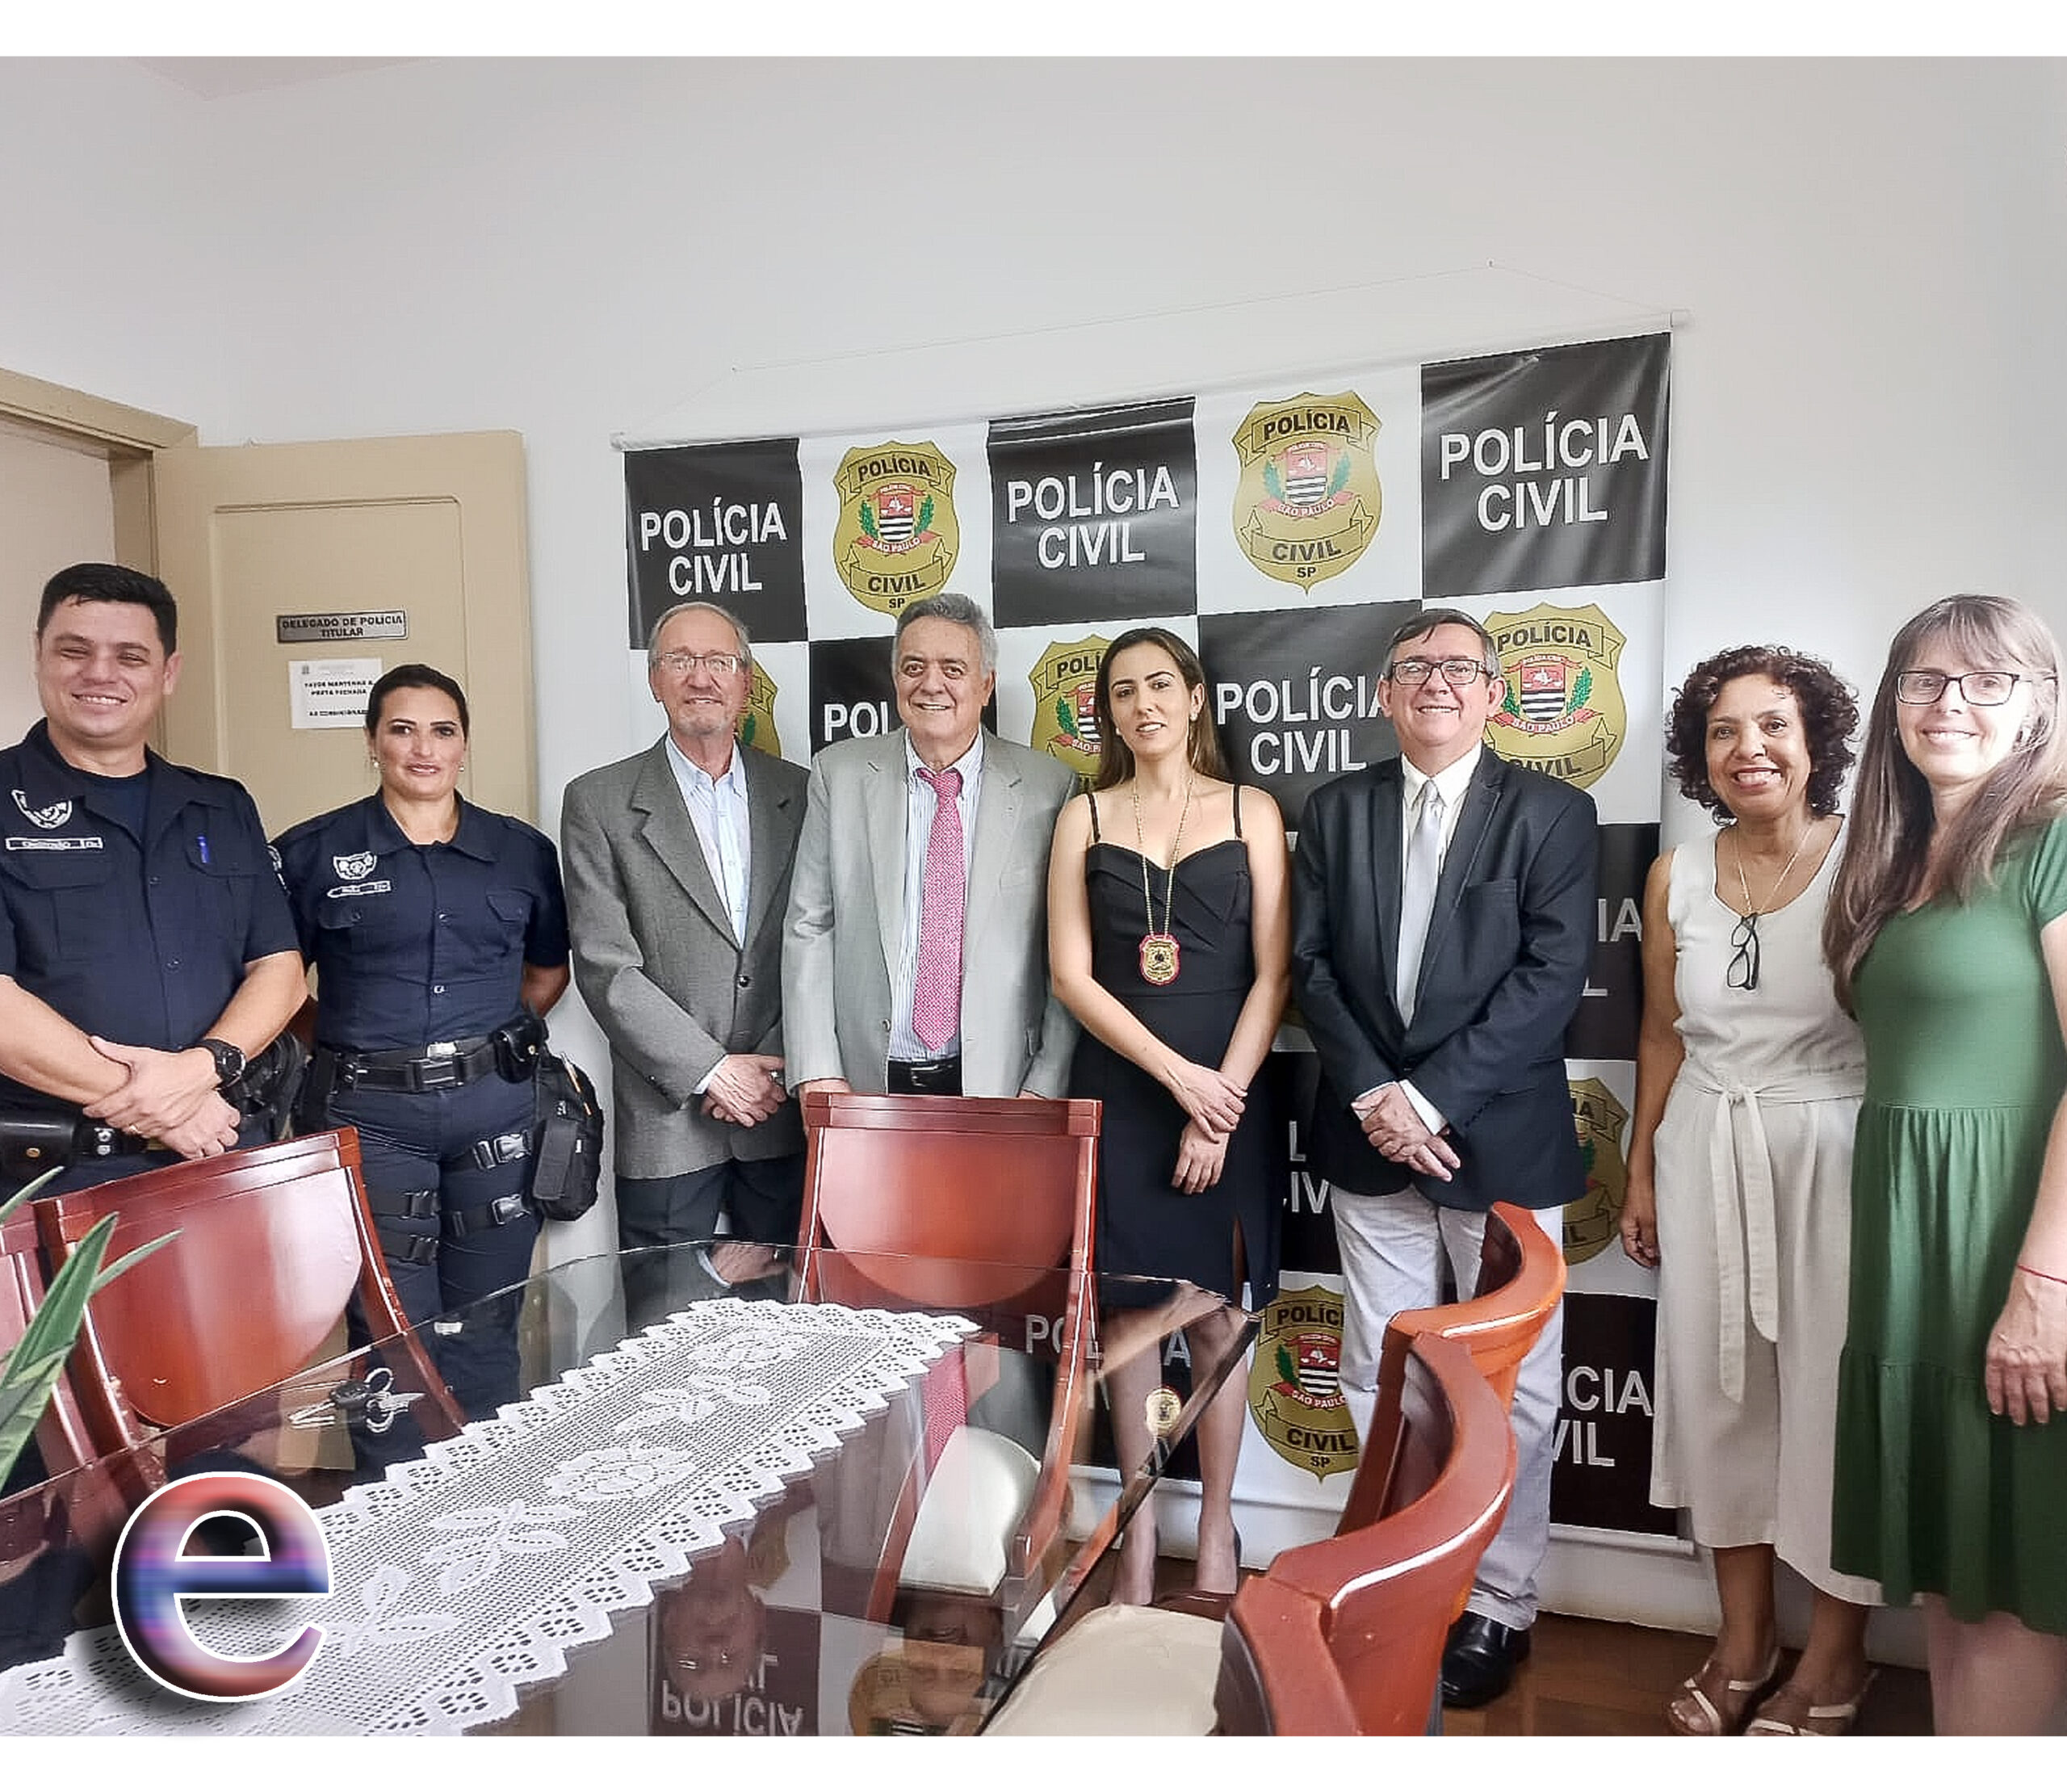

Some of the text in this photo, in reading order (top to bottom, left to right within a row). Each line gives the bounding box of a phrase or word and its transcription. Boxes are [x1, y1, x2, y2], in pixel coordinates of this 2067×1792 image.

[1264, 409, 1350, 440] POLÍCIA
[1440, 410, 1650, 481] POLÍCIA
[858, 454, 931, 482] POLÍCIA
[1008, 461, 1180, 523] POLÍCIA
[1478, 475, 1608, 532] CIVIL
[640, 497, 788, 551] POLÍCIA
[1038, 522, 1146, 569] CIVIL
[1272, 540, 1341, 561] CIVIL
[669, 552, 763, 596] CIVIL
[868, 573, 926, 593] CIVIL
[1297, 567, 1317, 578] SP
[889, 598, 906, 609] SP
[283, 618, 339, 629] DELEGADO
[343, 617, 357, 627] DE
[321, 627, 364, 637] TITULAR
[1497, 621, 1592, 652] POLÍCIA
[1056, 651, 1101, 679] POLÍ
[1538, 715, 1574, 732] PAULO
[1251, 728, 1367, 775] CIVIL
[1277, 1303, 1344, 1326] POLÍCI
[1314, 1395, 1348, 1408] PAULO
[1286, 1429, 1354, 1452] CIVIL
[1310, 1455, 1331, 1468] SP
